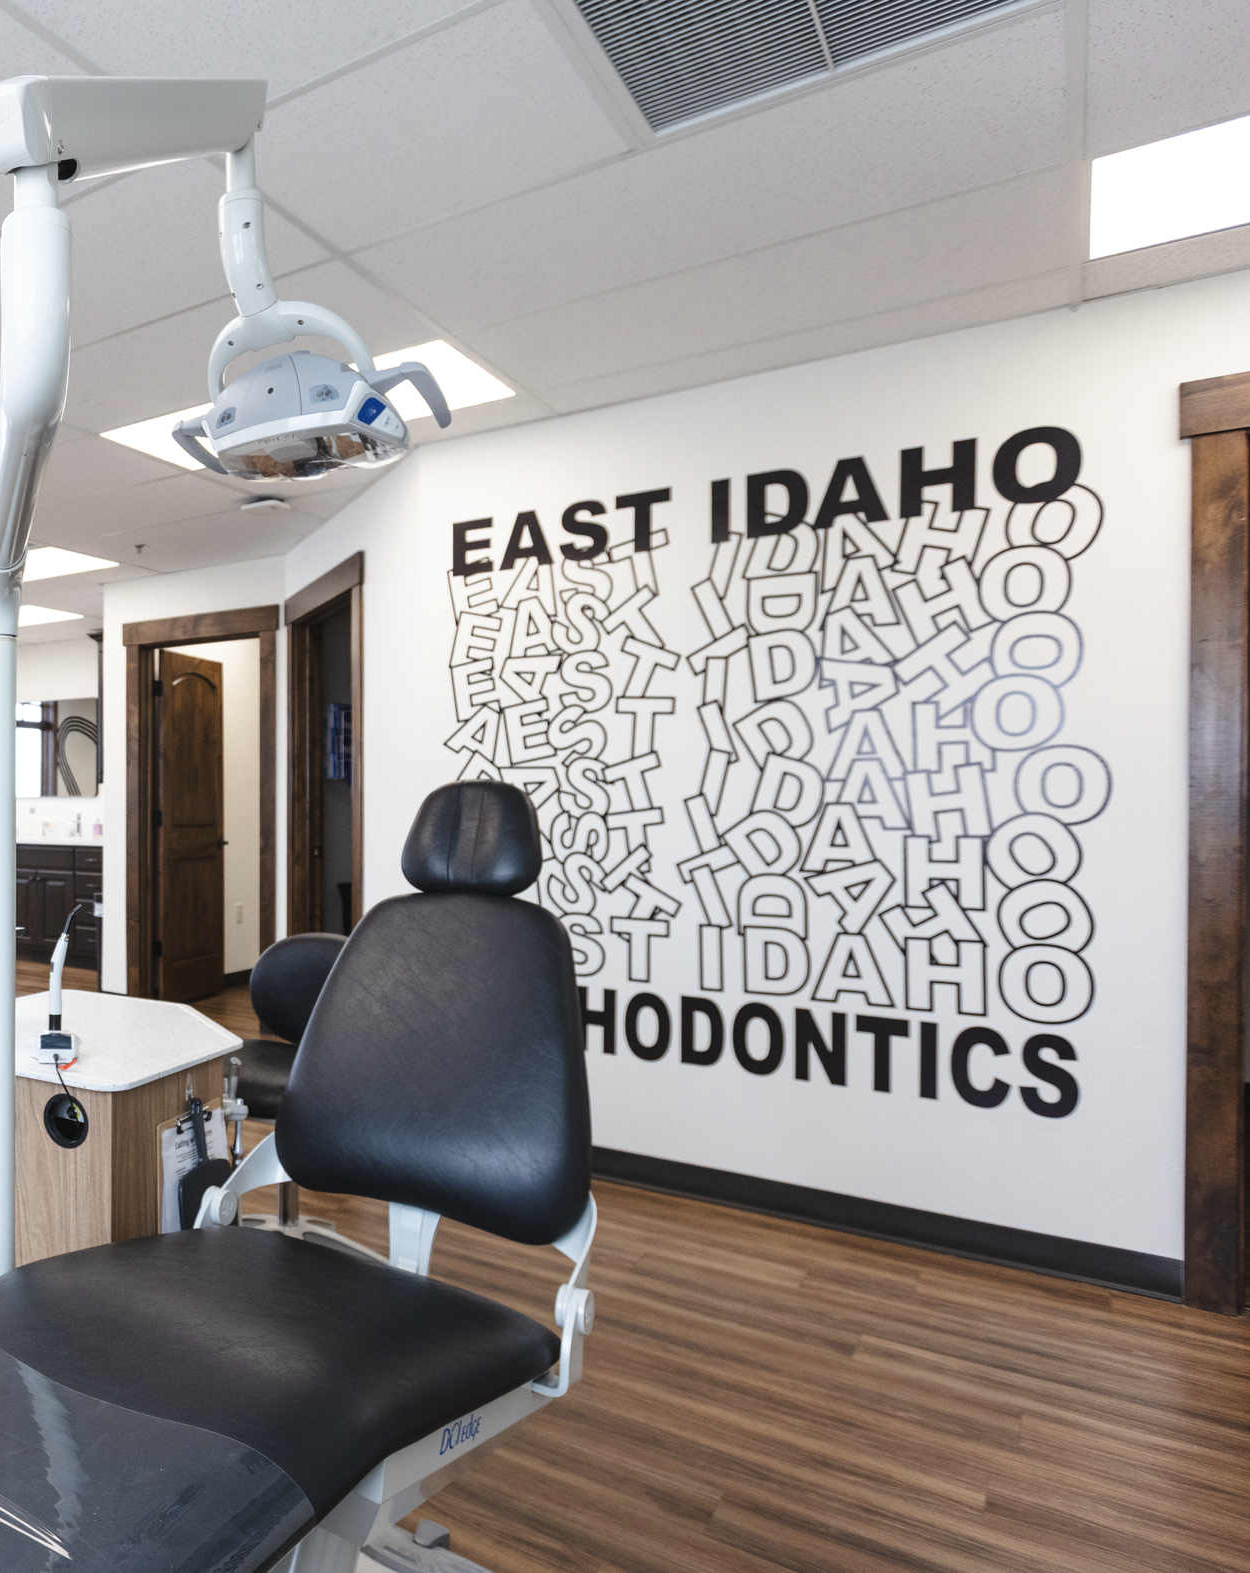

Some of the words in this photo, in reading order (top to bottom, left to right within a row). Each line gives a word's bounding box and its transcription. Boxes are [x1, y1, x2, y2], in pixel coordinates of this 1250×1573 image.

[452, 487, 672, 576] EAST
[710, 426, 1082, 544] IDAHO
[699, 923, 1095, 1025] IDAHO
[578, 985, 1081, 1119] HODONTICS
